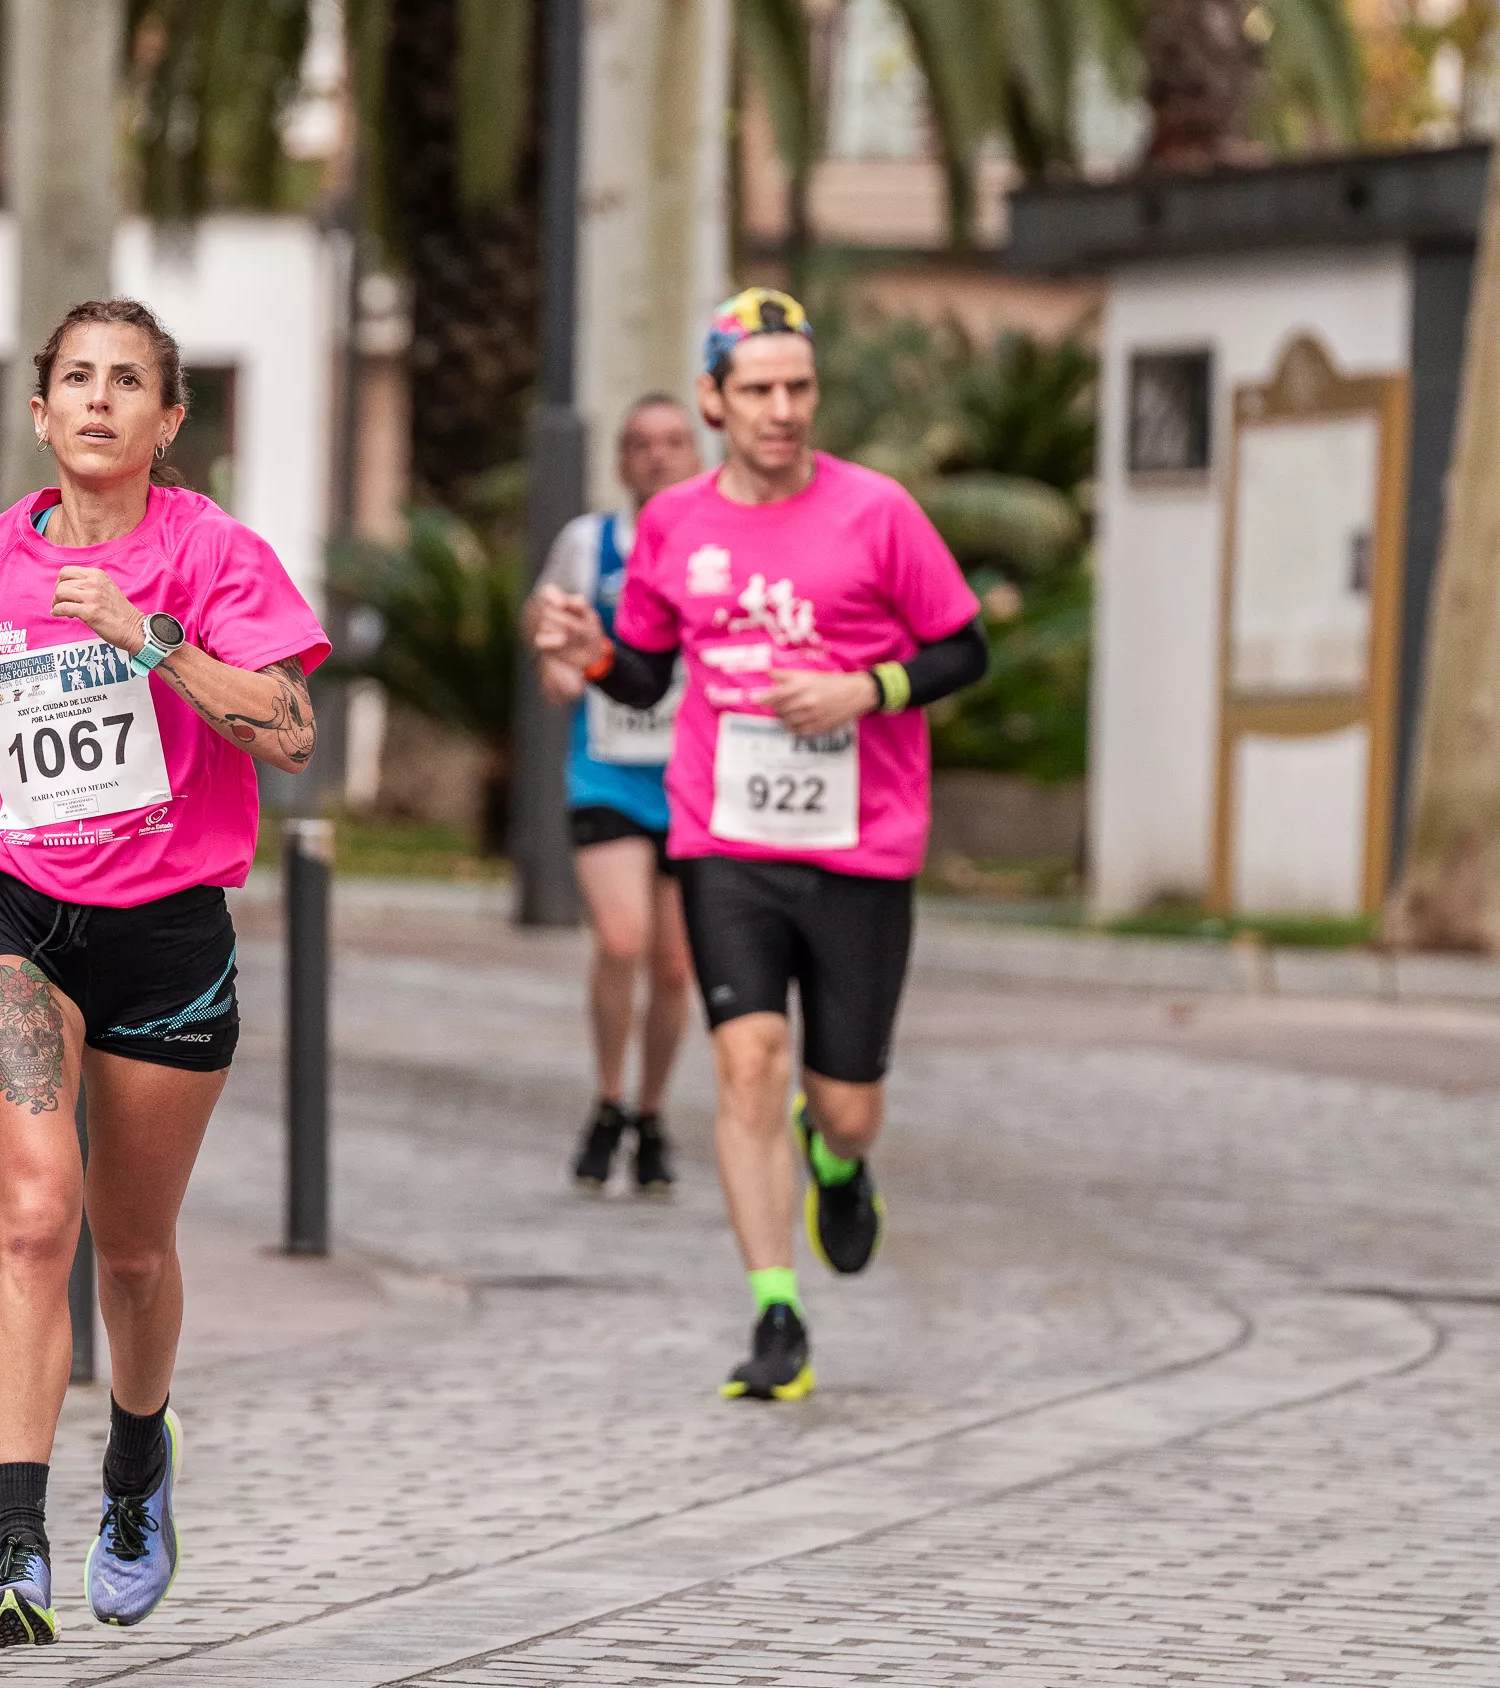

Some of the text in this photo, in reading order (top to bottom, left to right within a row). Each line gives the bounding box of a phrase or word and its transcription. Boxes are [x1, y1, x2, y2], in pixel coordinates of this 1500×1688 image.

[5, 656, 44, 672] PROVINCIAL
[45, 654, 55, 663] DE
[55, 644, 104, 671] 2024
[12, 663, 56, 679] POPULARES
[42, 700, 69, 712] CIUDAD
[69, 698, 80, 706] DE
[80, 693, 108, 705] LUCENA
[31, 706, 92, 724] POR LA IGUALDAD
[8, 712, 135, 784] 1067
[31, 780, 120, 803] MARIA POYATO MEDINA
[746, 773, 827, 814] 922
